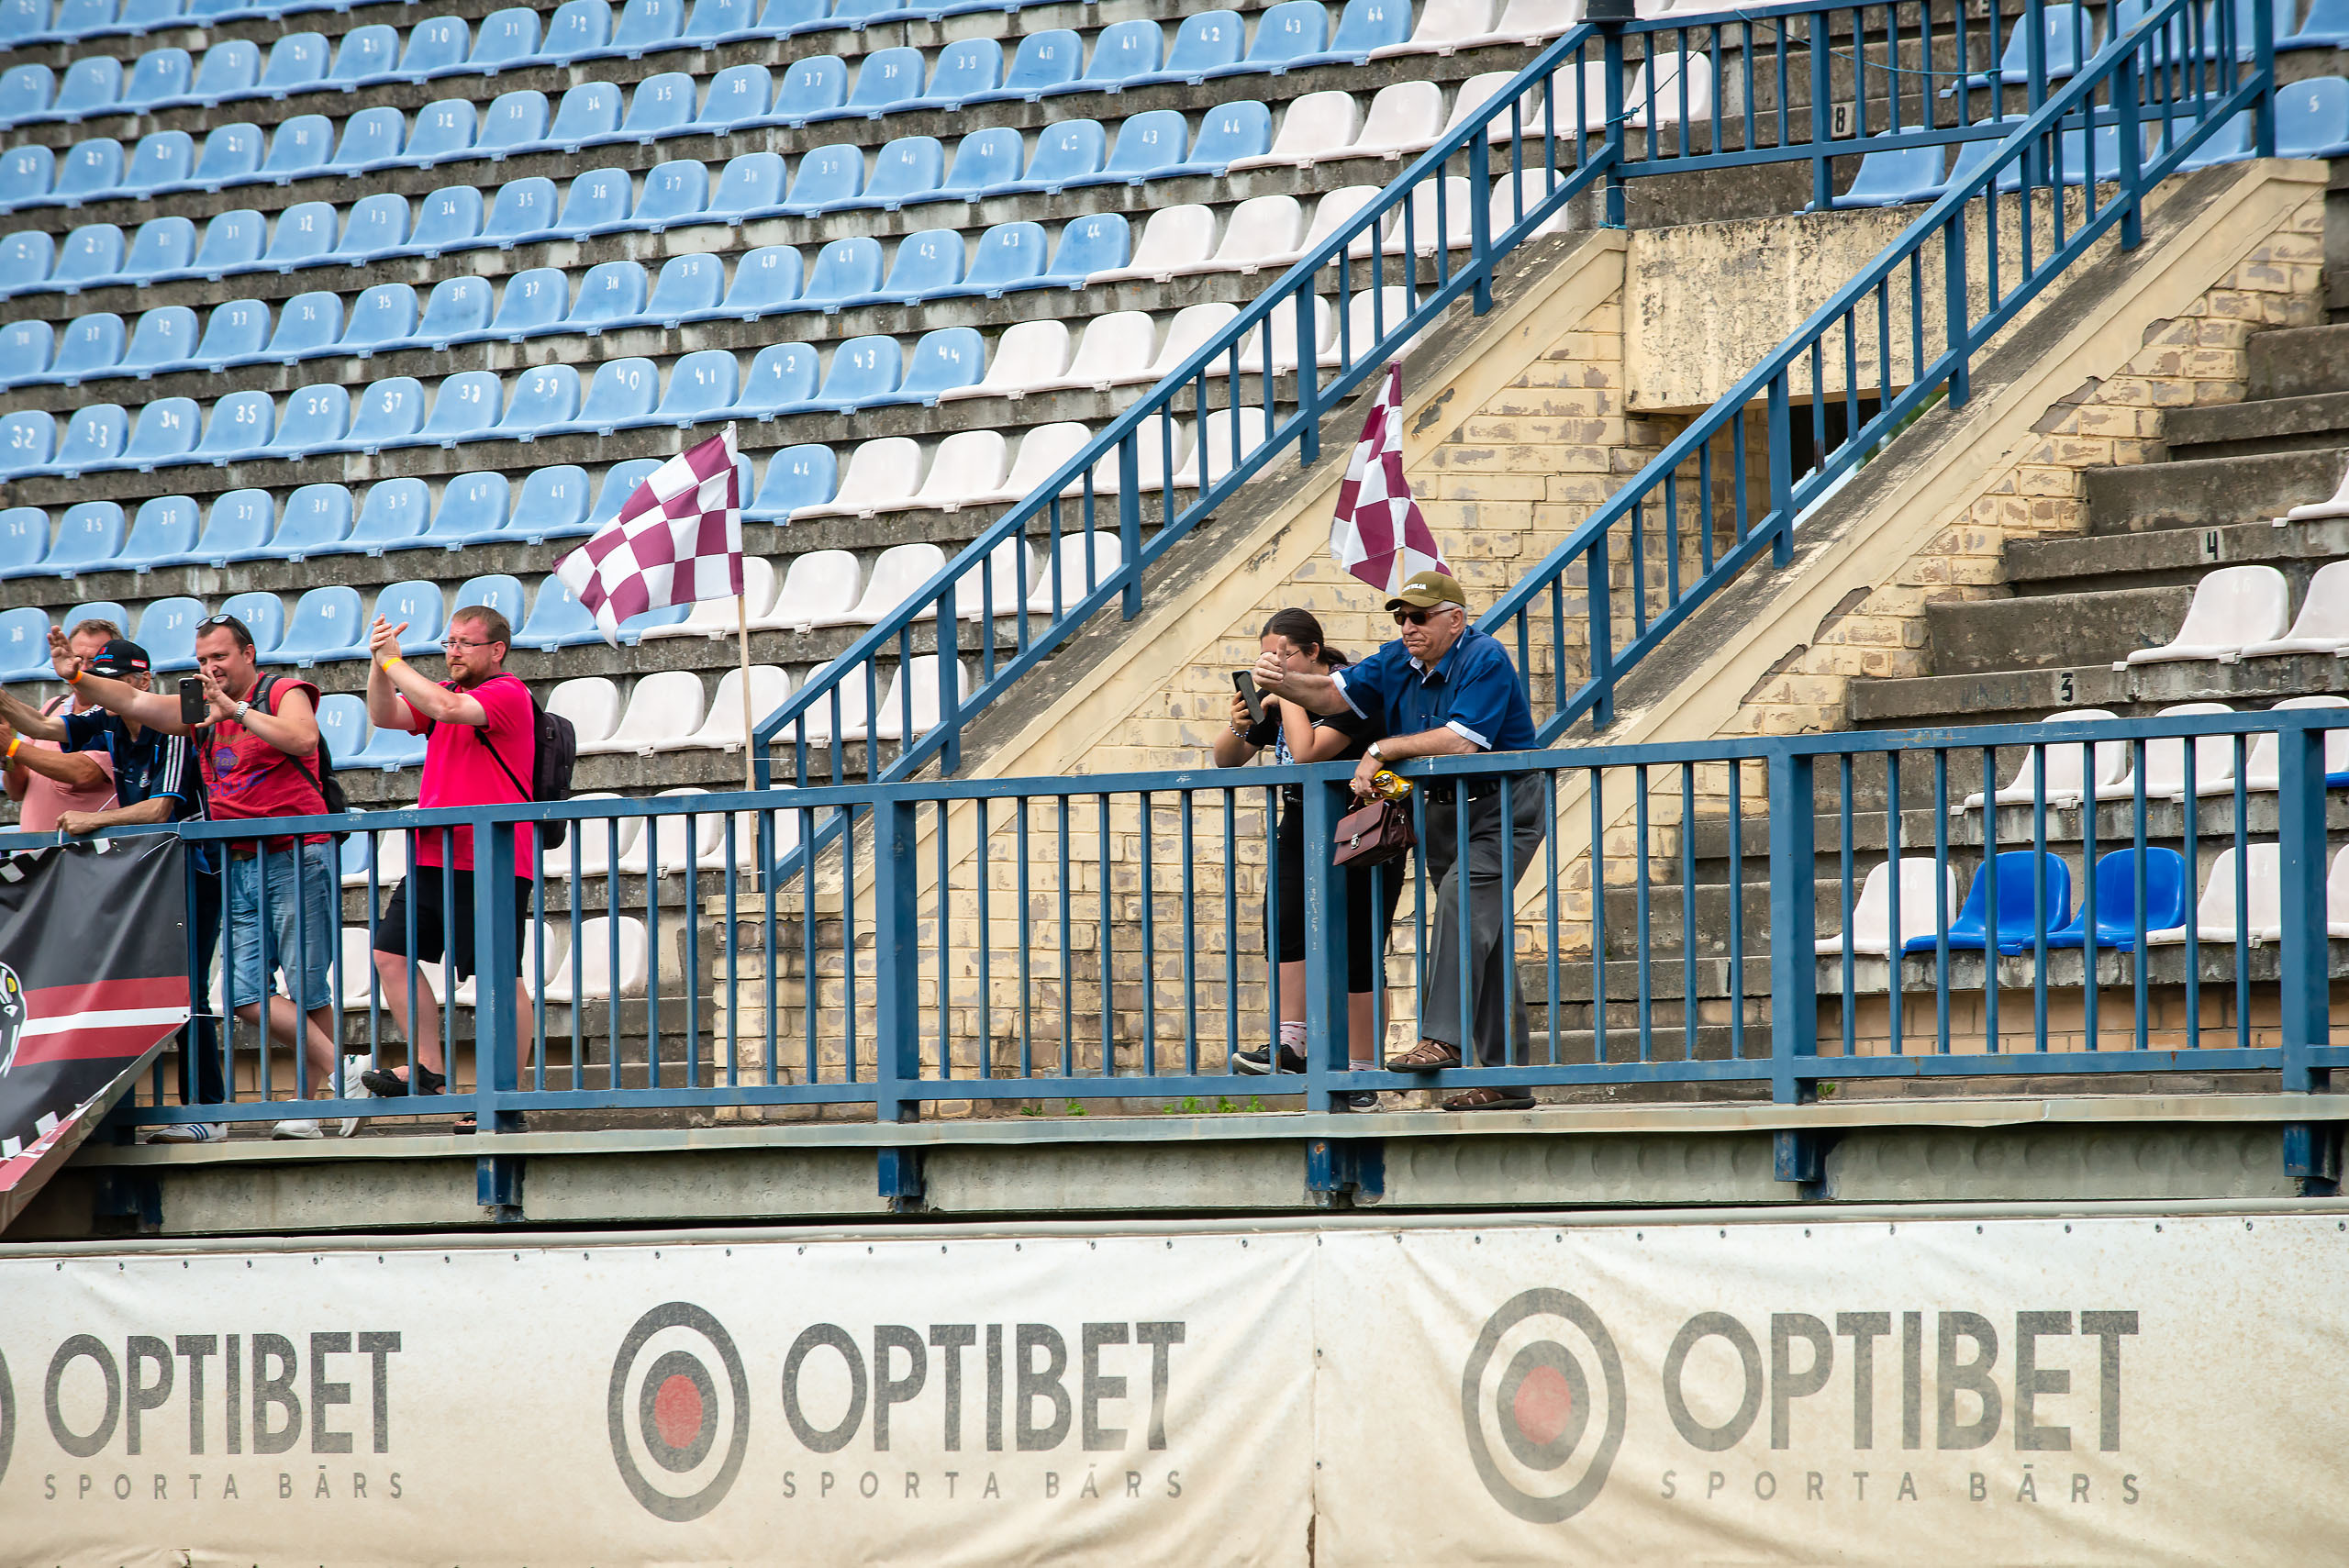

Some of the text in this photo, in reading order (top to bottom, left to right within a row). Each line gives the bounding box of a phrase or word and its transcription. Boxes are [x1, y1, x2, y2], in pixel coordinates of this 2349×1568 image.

[1367, 7, 1383, 22] 44
[1286, 18, 1300, 33] 43
[1201, 27, 1219, 41] 42
[1122, 36, 1136, 50] 41
[958, 55, 976, 70] 39
[733, 79, 746, 94] 36
[805, 72, 822, 86] 37
[657, 86, 672, 101] 35
[510, 105, 523, 118] 33
[587, 96, 600, 111] 34
[2309, 95, 2320, 113] 5
[438, 113, 454, 128] 32
[1223, 119, 1240, 134] 44
[1836, 106, 1845, 133] 8
[1142, 130, 1157, 145] 43
[981, 143, 994, 156] 41
[822, 161, 838, 174] 39
[593, 184, 607, 198] 36
[666, 176, 682, 191] 37
[518, 193, 533, 207] 35
[442, 201, 455, 216] 34
[1002, 232, 1019, 247] 43
[1087, 224, 1100, 239] 44
[839, 248, 853, 262] 41
[920, 243, 936, 260] 42
[682, 261, 698, 278] 39
[452, 286, 466, 301] 36
[525, 281, 540, 297] 37
[378, 295, 392, 309] 35
[232, 311, 248, 326] 33
[854, 350, 875, 370] 43
[939, 346, 960, 363] 44
[773, 356, 795, 379] 42
[617, 366, 640, 390] 40
[696, 368, 715, 384] 41
[461, 384, 481, 403] 38
[534, 378, 558, 396] 39
[308, 397, 328, 415] 36
[382, 392, 403, 413] 37
[161, 410, 179, 429] 34
[236, 405, 256, 424] 35
[11, 426, 35, 449] 32
[87, 421, 108, 448] 33
[551, 484, 564, 498] 41
[238, 505, 253, 520] 37
[86, 517, 103, 532] 35
[2206, 531, 2218, 561] 4
[400, 599, 415, 615] 41
[482, 591, 497, 608] 42
[2061, 673, 2073, 702] 3
[328, 710, 342, 727] 42
[782, 1321, 1186, 1453] OPTIBET
[1663, 1310, 2139, 1452] OPTIBET
[44, 1331, 402, 1458] OPTIBET
[44, 1464, 402, 1500] SPORTA BĀRS
[783, 1464, 1183, 1498] SPORTA BĀRS
[1661, 1464, 2140, 1505] SPORTA BĀRS
